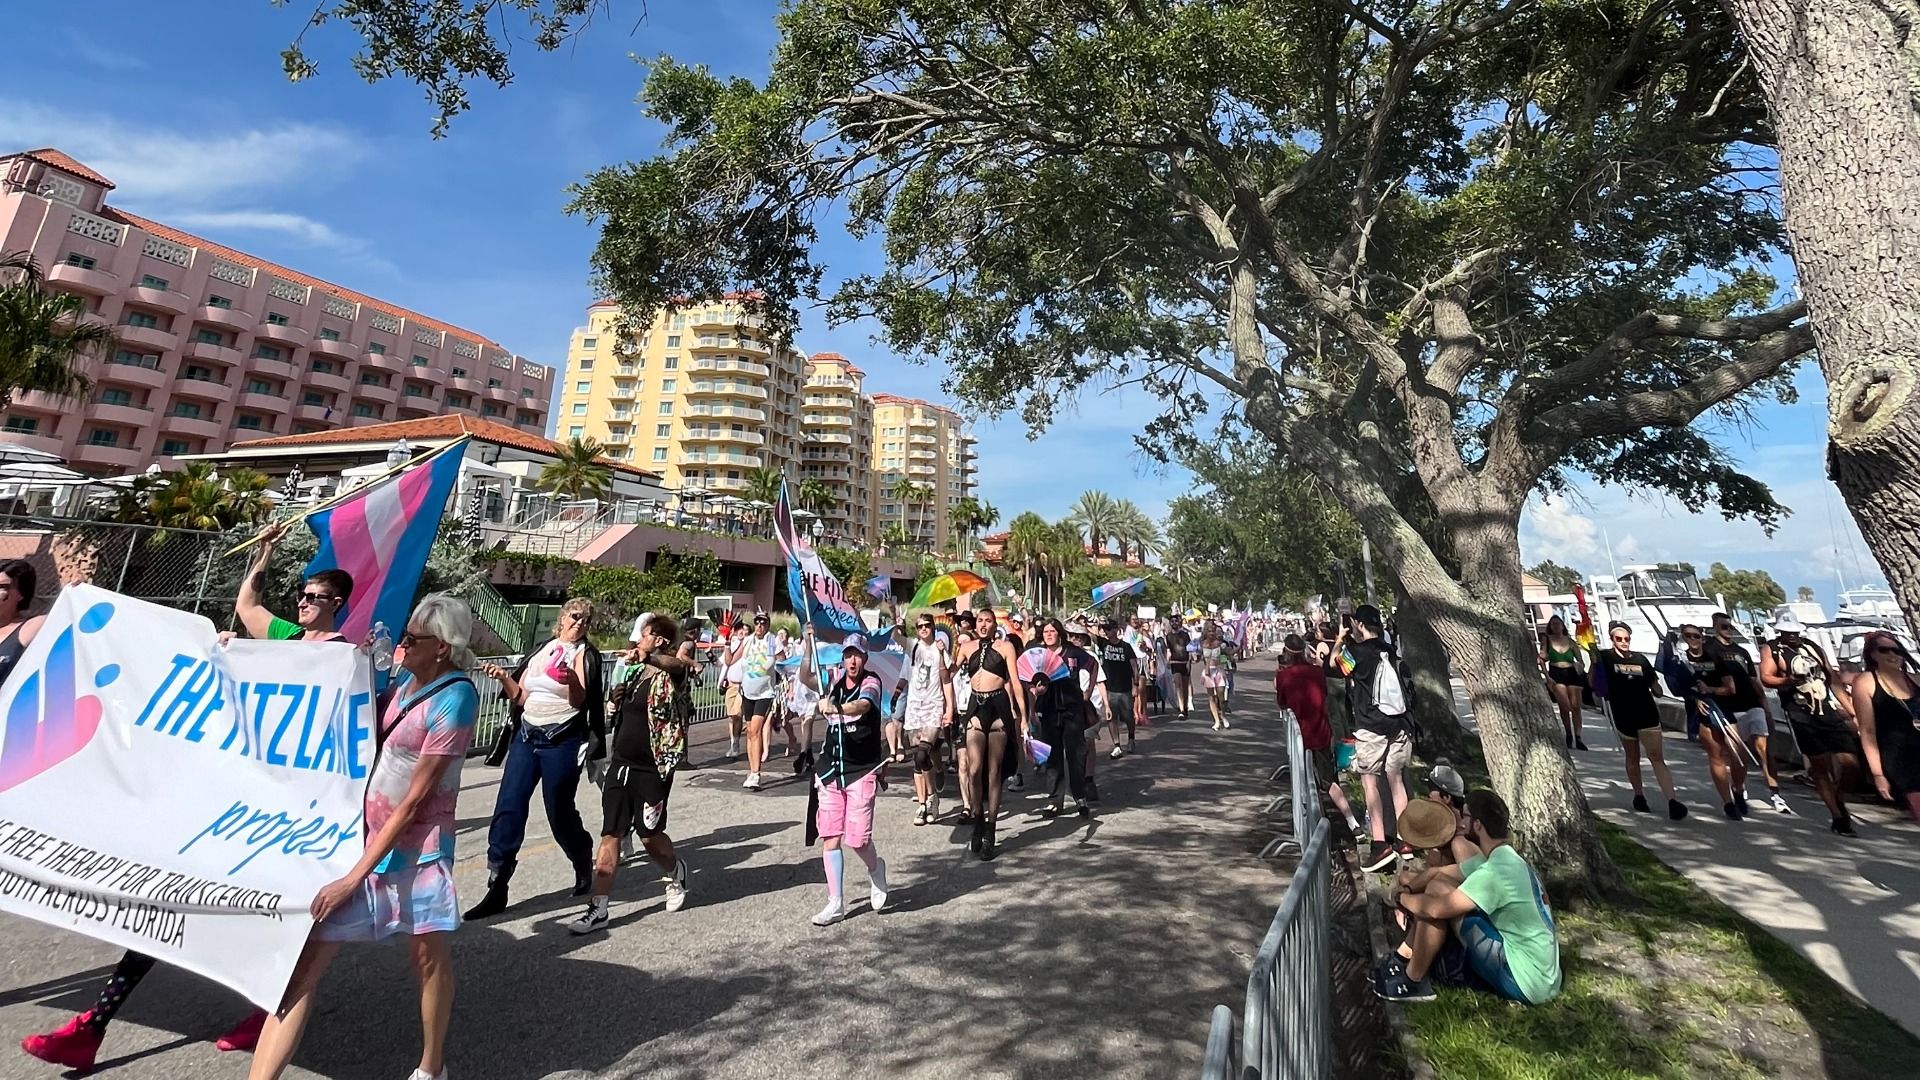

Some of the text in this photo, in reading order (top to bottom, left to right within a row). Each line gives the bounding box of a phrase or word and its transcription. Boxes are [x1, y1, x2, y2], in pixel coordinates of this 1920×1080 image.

[1104, 651, 1125, 661] SUCKS
[134, 653, 225, 743] THE
[0, 826, 57, 861] FREE
[37, 841, 128, 885] THERAPY
[114, 862, 162, 897] FOR
[178, 799, 363, 876] project
[112, 896, 186, 950] FLORIDA
